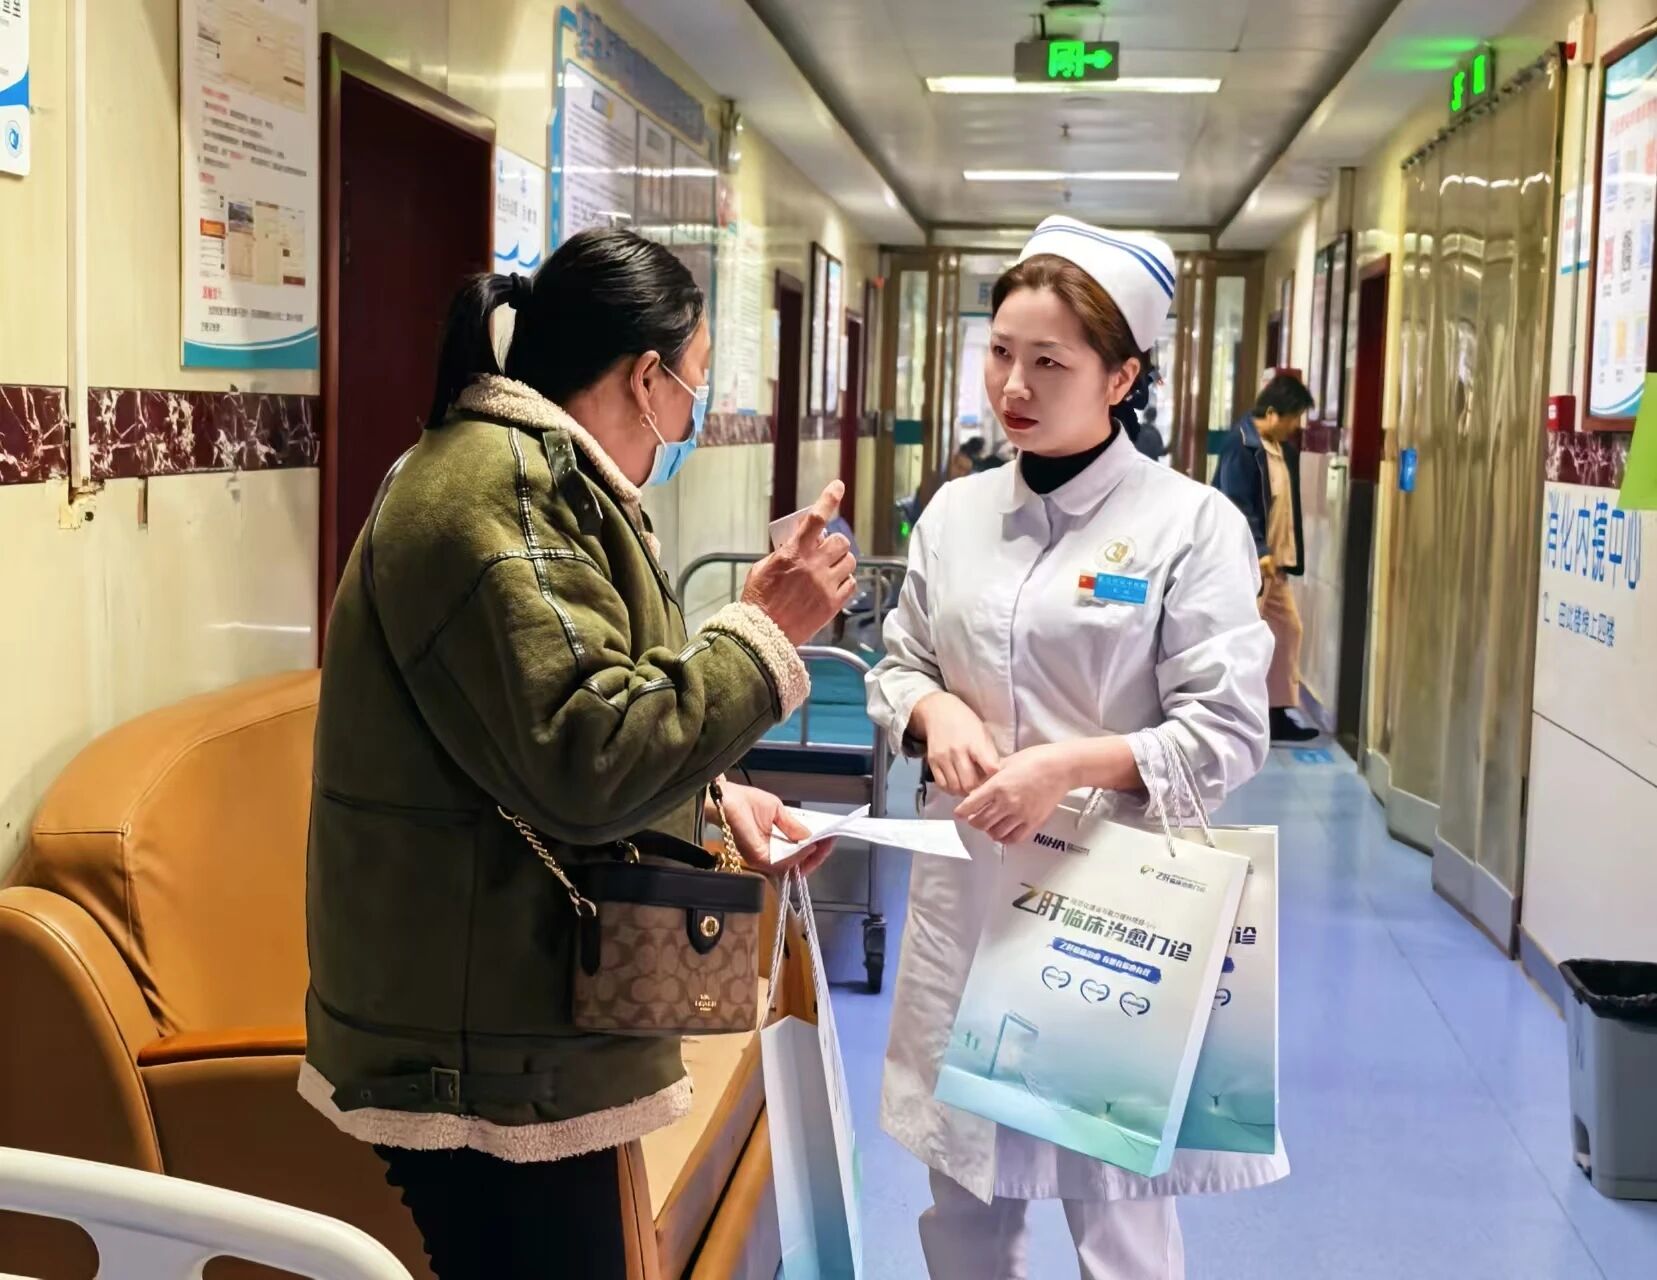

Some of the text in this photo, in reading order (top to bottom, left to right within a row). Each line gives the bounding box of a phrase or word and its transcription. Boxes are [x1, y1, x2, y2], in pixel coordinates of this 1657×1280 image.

[1546, 491, 1642, 590] 消化内镜中心
[1011, 882, 1193, 962] 乙肝临床治愈门诊
